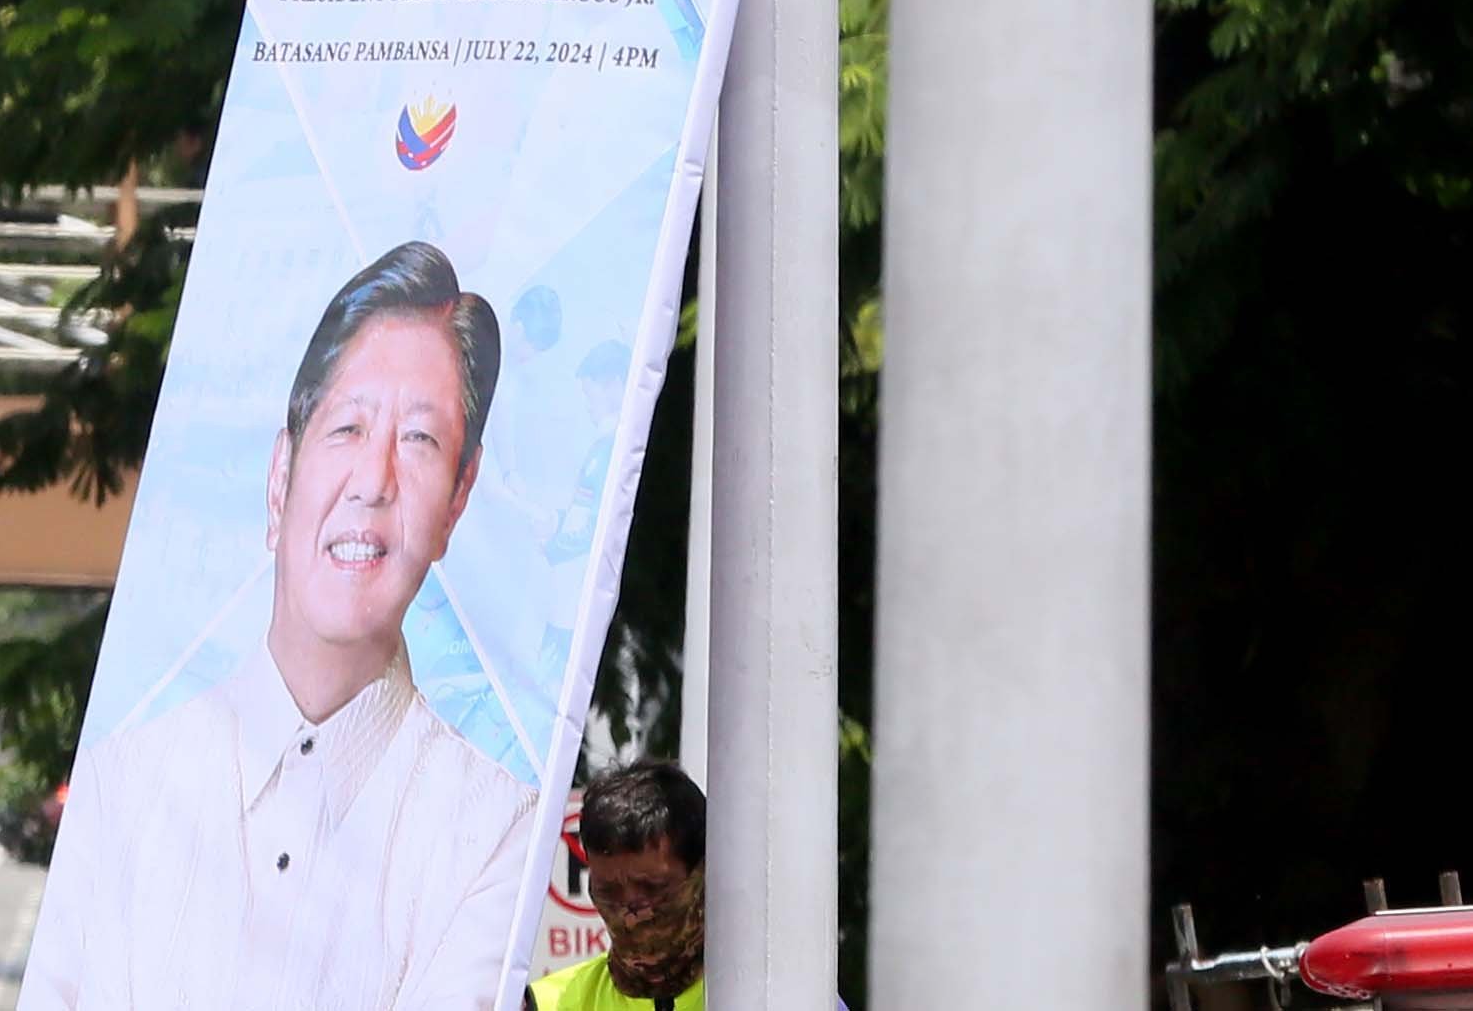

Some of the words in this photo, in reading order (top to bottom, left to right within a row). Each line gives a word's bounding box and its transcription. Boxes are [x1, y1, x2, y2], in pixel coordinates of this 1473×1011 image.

[252, 41, 352, 63] BATASANG
[354, 40, 450, 62] PAMBANSA
[462, 40, 510, 64] JULY
[512, 42, 541, 65] 22,
[545, 42, 593, 65] 2024
[612, 45, 661, 70] 4PM
[548, 926, 608, 958] BIK
